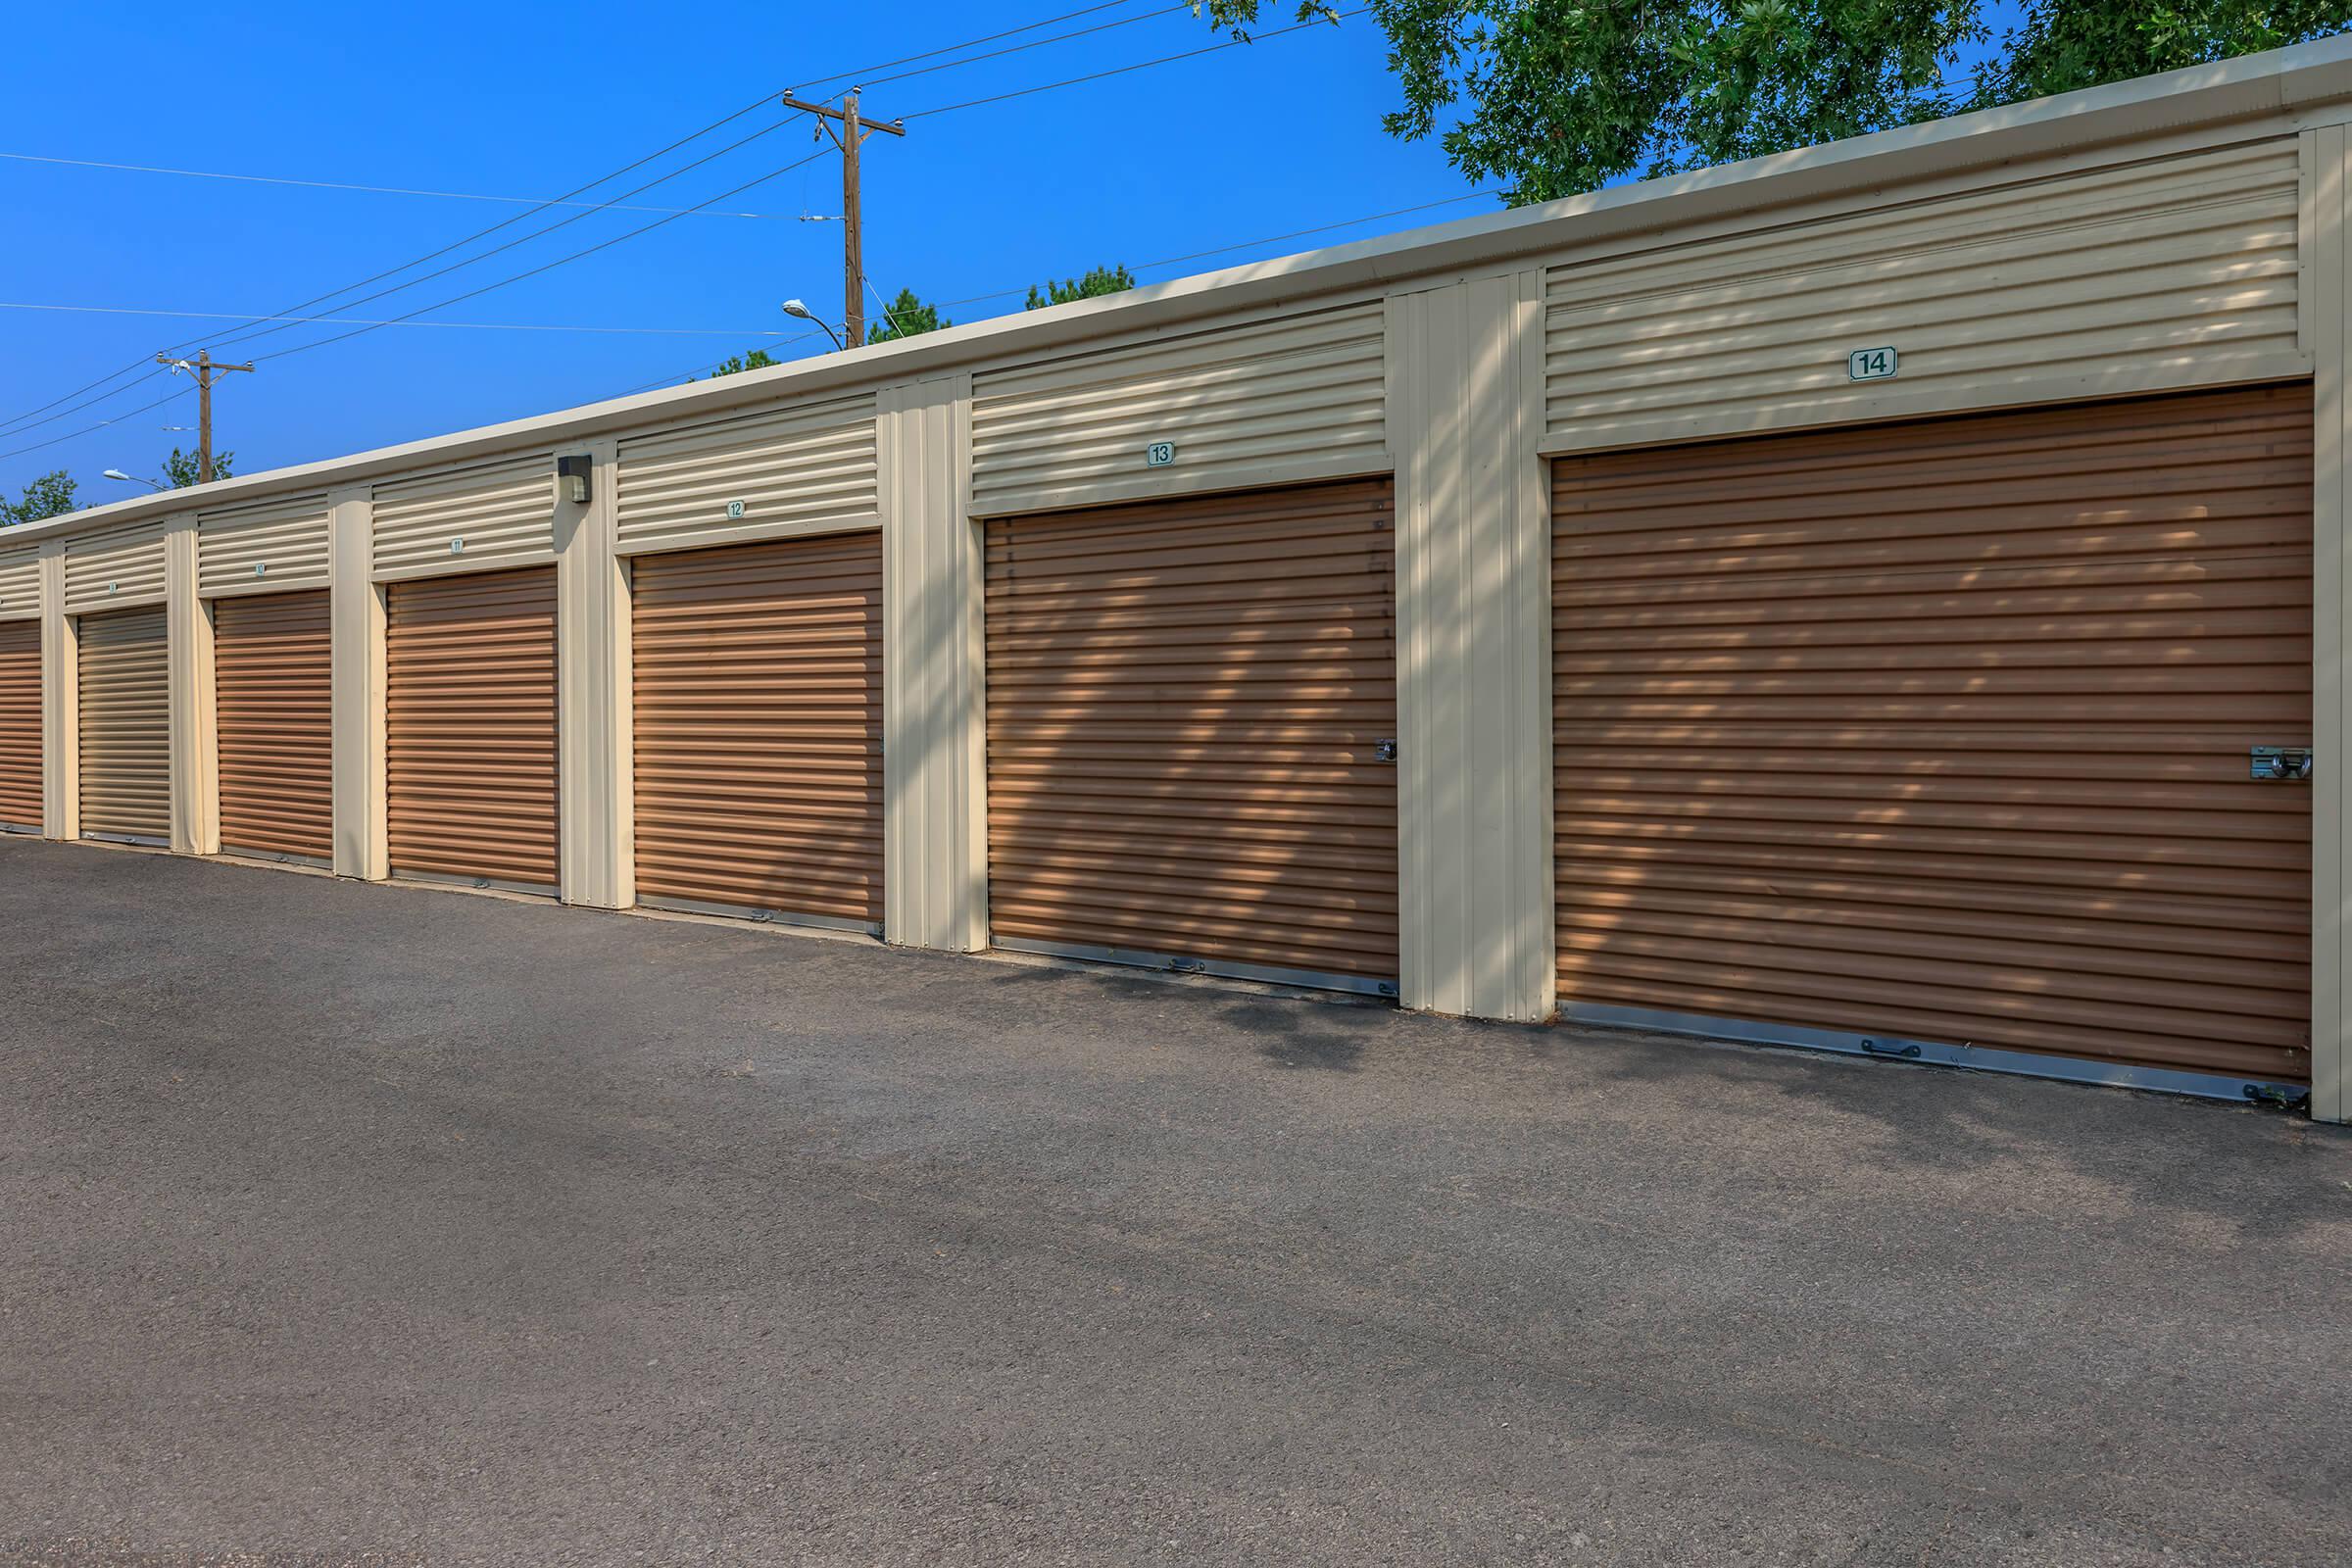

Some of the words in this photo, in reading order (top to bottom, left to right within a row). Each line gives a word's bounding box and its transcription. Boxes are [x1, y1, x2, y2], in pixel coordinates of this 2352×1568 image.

[1859, 352, 1887, 374] 14
[1152, 445, 1169, 462] 13
[730, 503, 741, 515] 12
[454, 540, 461, 551] 11
